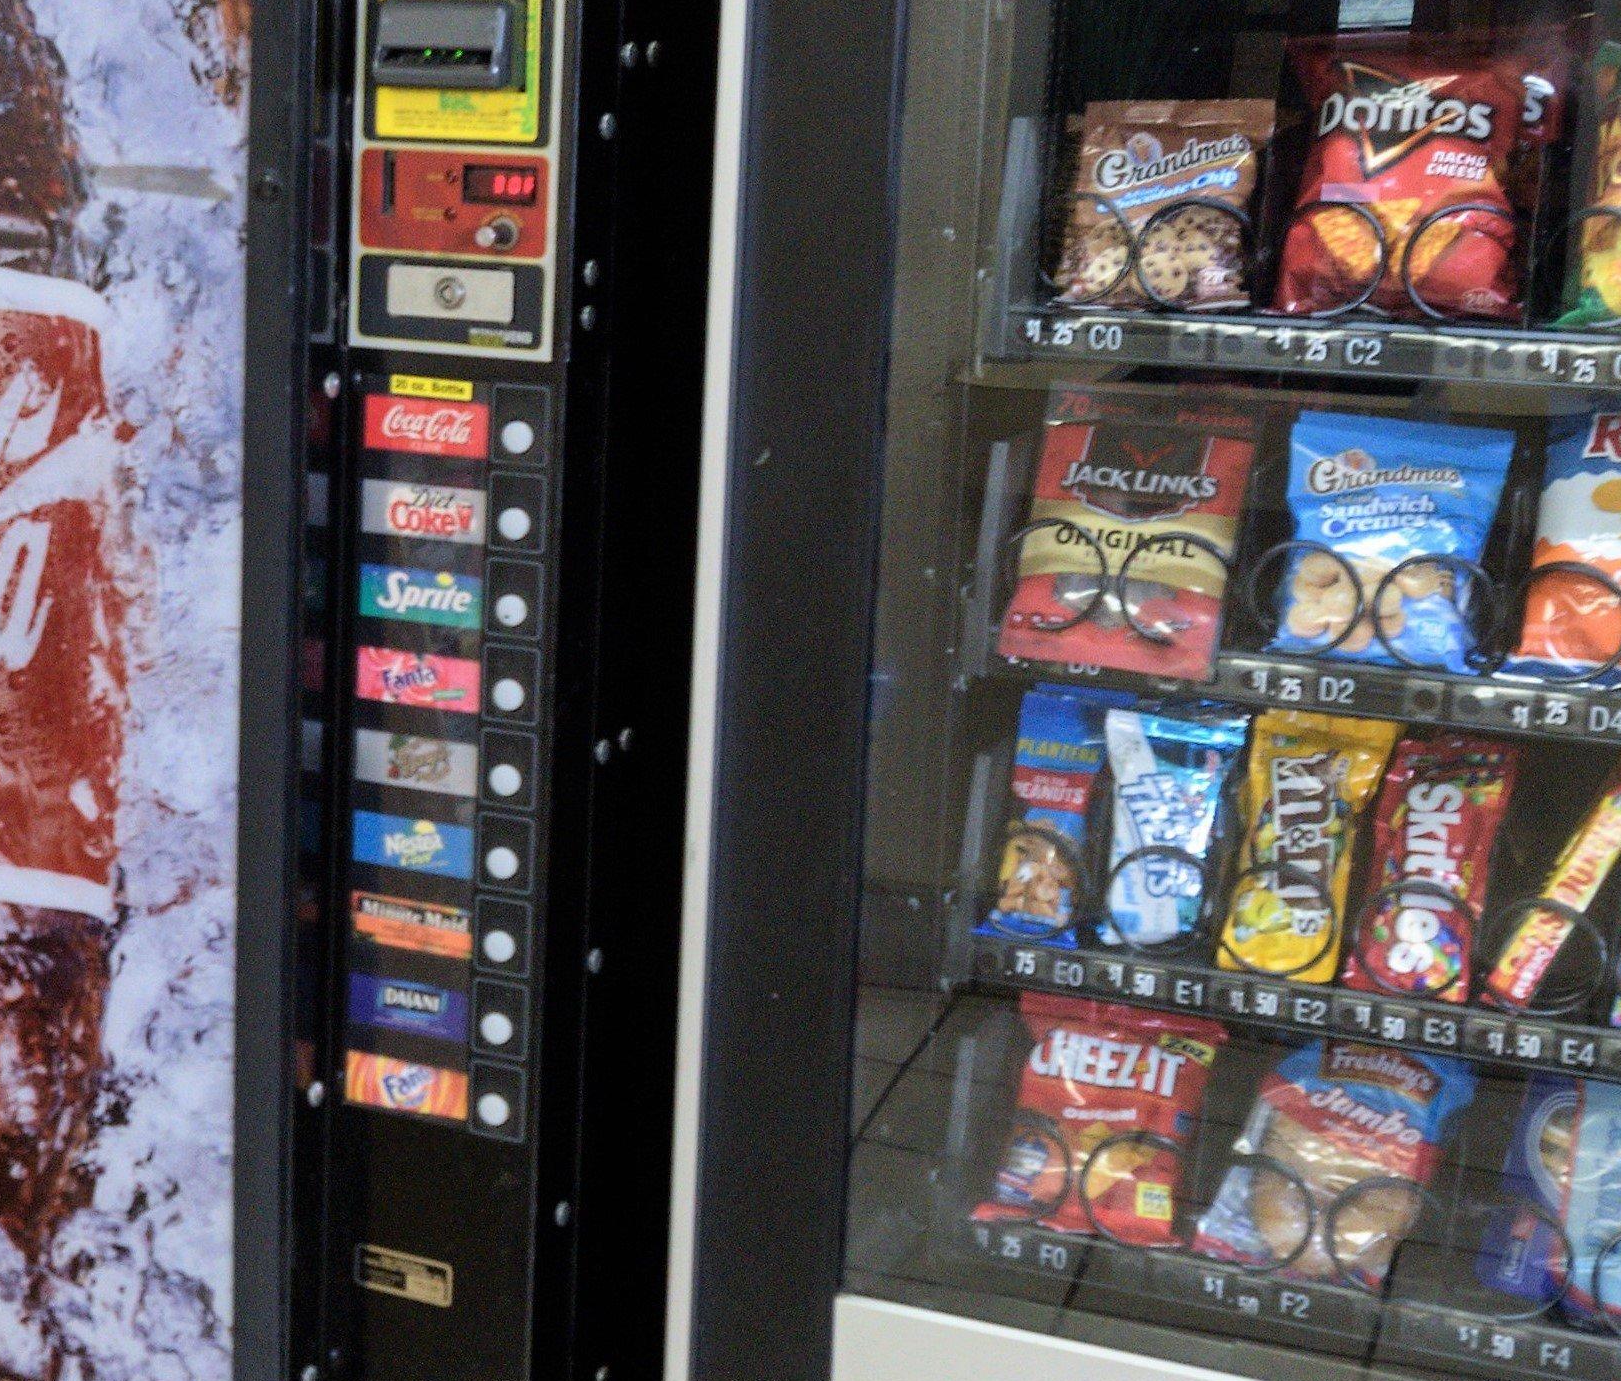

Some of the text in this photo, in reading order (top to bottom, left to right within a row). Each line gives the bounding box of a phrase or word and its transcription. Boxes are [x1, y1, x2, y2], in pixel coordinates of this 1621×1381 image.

[1425, 163, 1487, 182] CHEESE
[1431, 150, 1489, 169] NACHO
[1088, 325, 1124, 351] C0
[1345, 338, 1381, 365] C2
[431, 381, 466, 396] Bottle
[381, 403, 474, 447] Coca-Cola
[1061, 462, 1135, 489] JACK
[415, 486, 456, 509] Diet
[1319, 496, 1437, 520] Sandwich
[388, 498, 457, 535] Coke
[1321, 513, 1429, 537] Cremes
[1053, 522, 1197, 559] ORIGINAL
[377, 570, 473, 615] Sprite
[382, 666, 438, 692] Fanta
[1318, 676, 1356, 704] D2
[1386, 781, 1465, 976] Skittles
[361, 898, 470, 933] Minute Maid
[1051, 960, 1086, 988] E0
[383, 987, 442, 1014] DASANI
[1173, 979, 1205, 1007] E1
[1294, 996, 1326, 1025] E2
[1423, 1016, 1457, 1047] E3
[1559, 1037, 1595, 1065] E4
[383, 1067, 435, 1100] Fanta
[1309, 1085, 1425, 1146] Jumbo
[1039, 1243, 1068, 1270] F0
[1280, 1292, 1312, 1319] F2
[1539, 1343, 1572, 1370] F4
